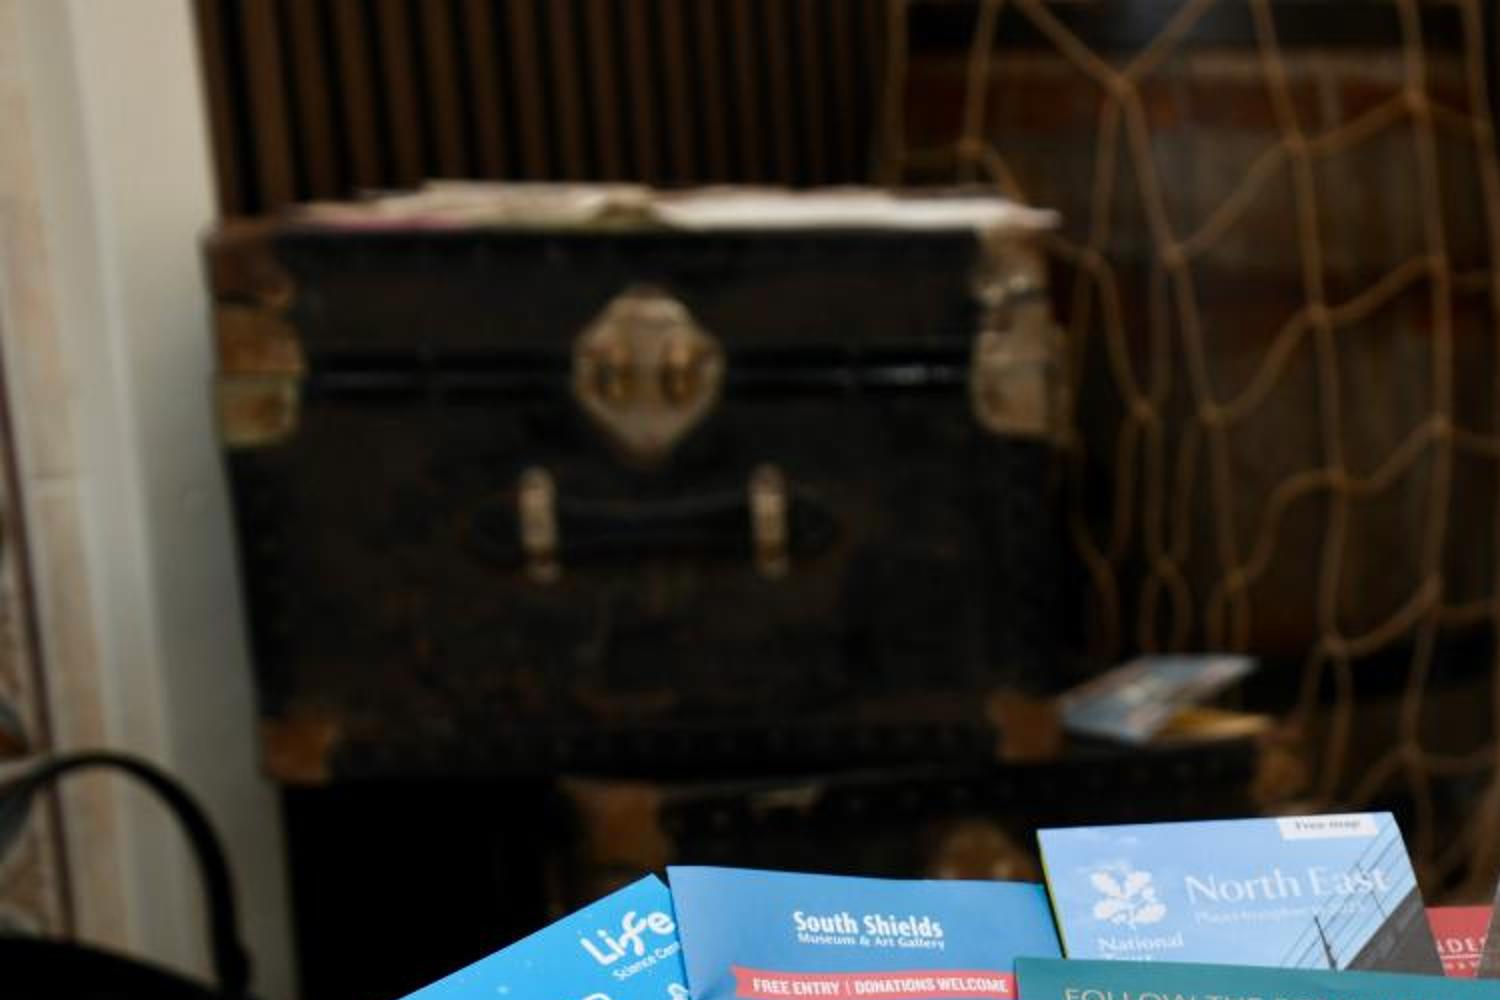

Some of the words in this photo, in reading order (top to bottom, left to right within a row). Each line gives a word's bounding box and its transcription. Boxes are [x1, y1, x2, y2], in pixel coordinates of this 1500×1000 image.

[1184, 868, 1301, 904] North
[1308, 864, 1391, 897] East
[793, 911, 858, 934] South
[864, 913, 943, 938] Shields
[581, 911, 676, 965] Life
[797, 932, 855, 945] Museum
[859, 935, 869, 946] &
[875, 937, 894, 947] Art
[897, 938, 944, 951] Gallery
[613, 954, 657, 980] Science
[753, 978, 790, 994] FREE
[794, 980, 840, 995] ENTRY
[855, 978, 935, 994] DONATIONS
[937, 977, 1009, 993] WELCOME
